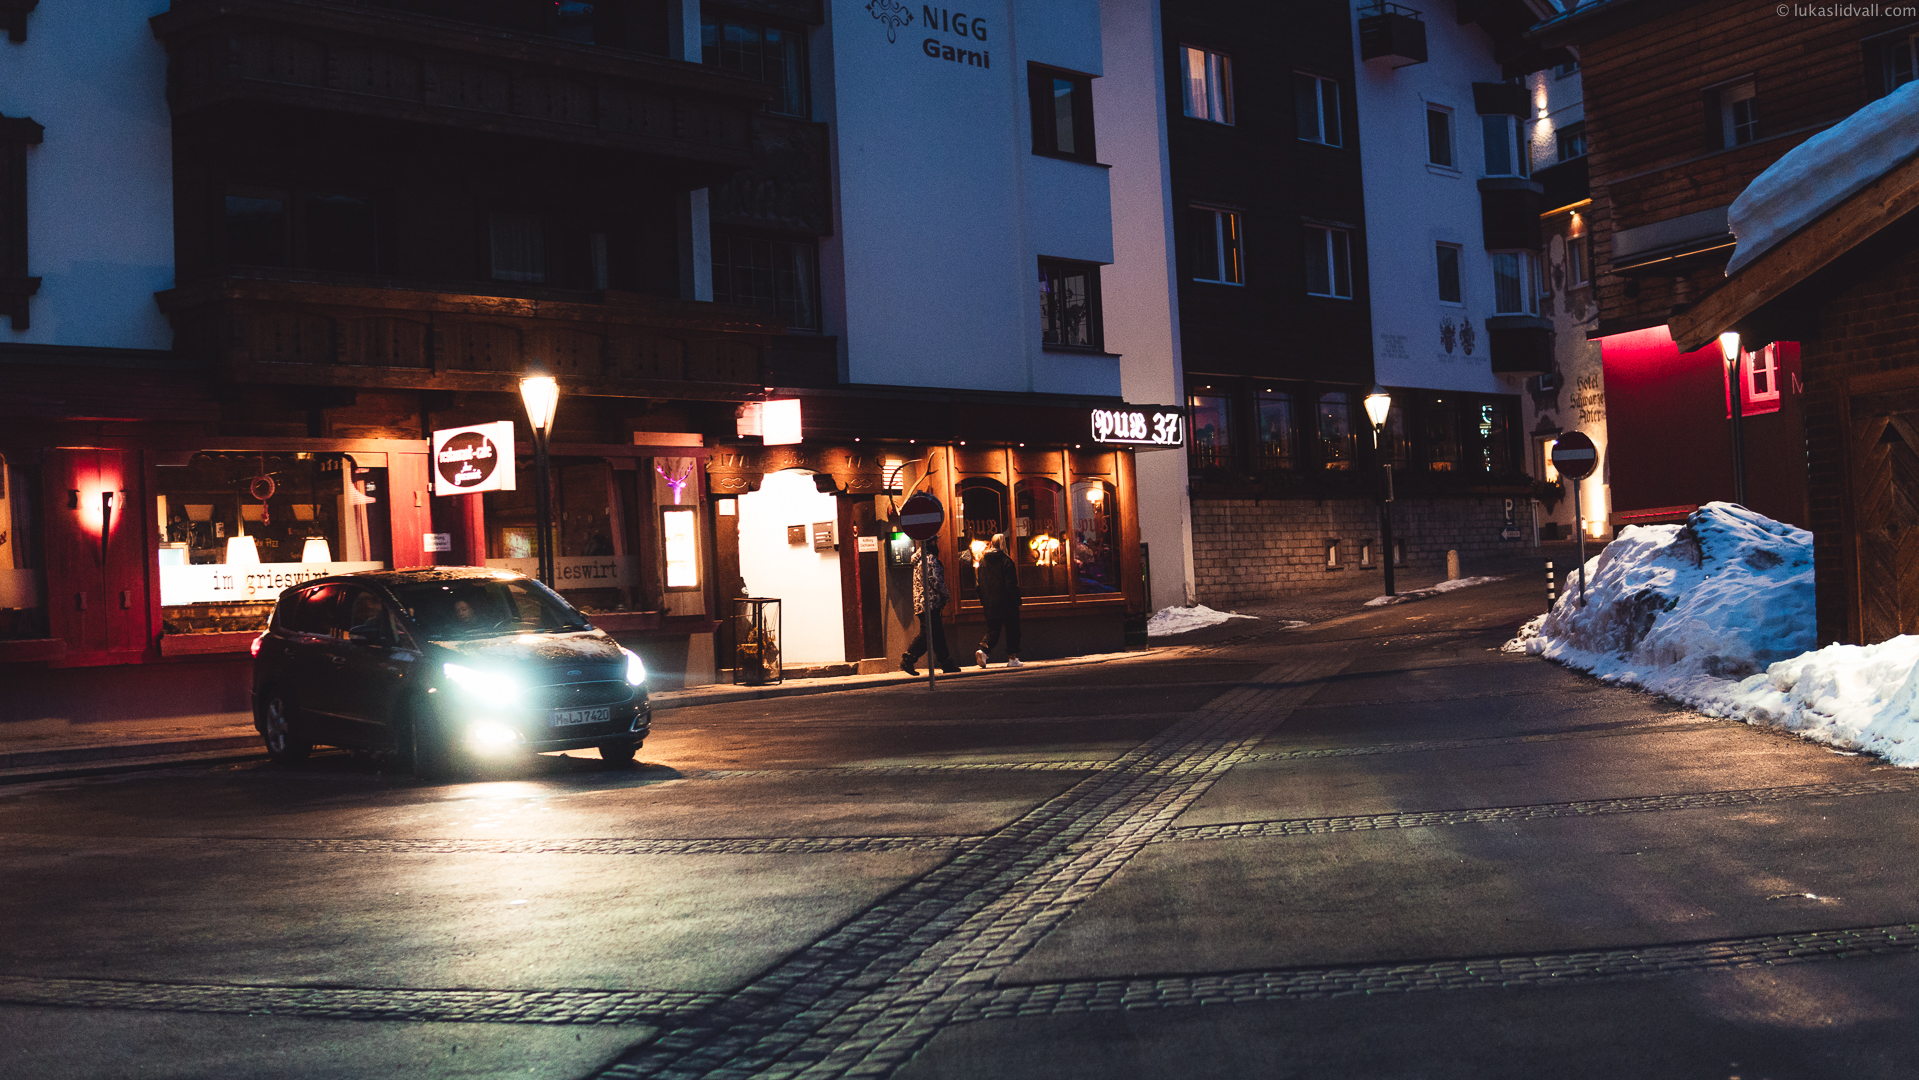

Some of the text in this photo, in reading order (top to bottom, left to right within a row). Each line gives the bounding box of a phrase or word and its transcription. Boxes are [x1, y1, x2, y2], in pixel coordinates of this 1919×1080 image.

[923, 5, 988, 42] NIGG
[922, 38, 990, 69] Garni
[1151, 412, 1179, 445] 37
[213, 570, 234, 590] im
